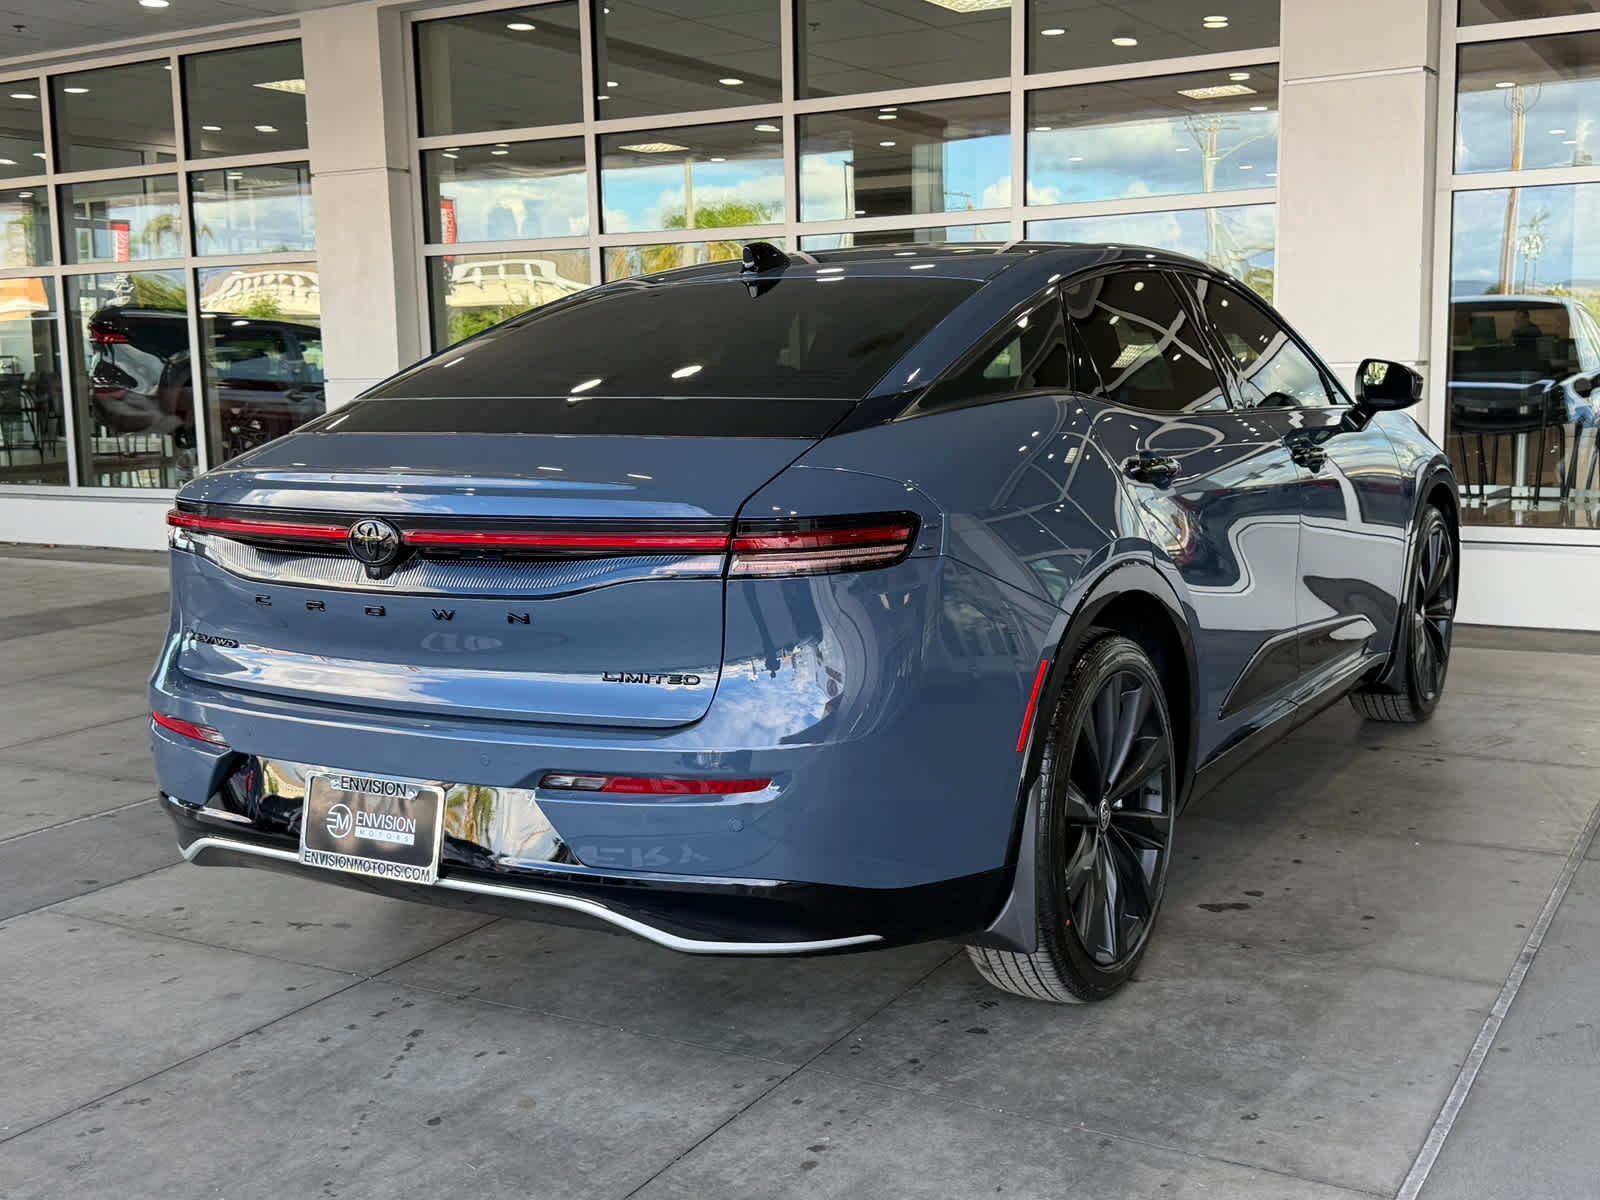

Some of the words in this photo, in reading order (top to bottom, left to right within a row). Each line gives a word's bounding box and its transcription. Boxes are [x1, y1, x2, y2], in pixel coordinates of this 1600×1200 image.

[254, 594, 531, 625] CROWN
[601, 671, 701, 686] LIMITED
[340, 776, 407, 797] ENVISION
[356, 811, 416, 833] ENVISION
[304, 850, 430, 883] ENVISIONMOTORS.COM
